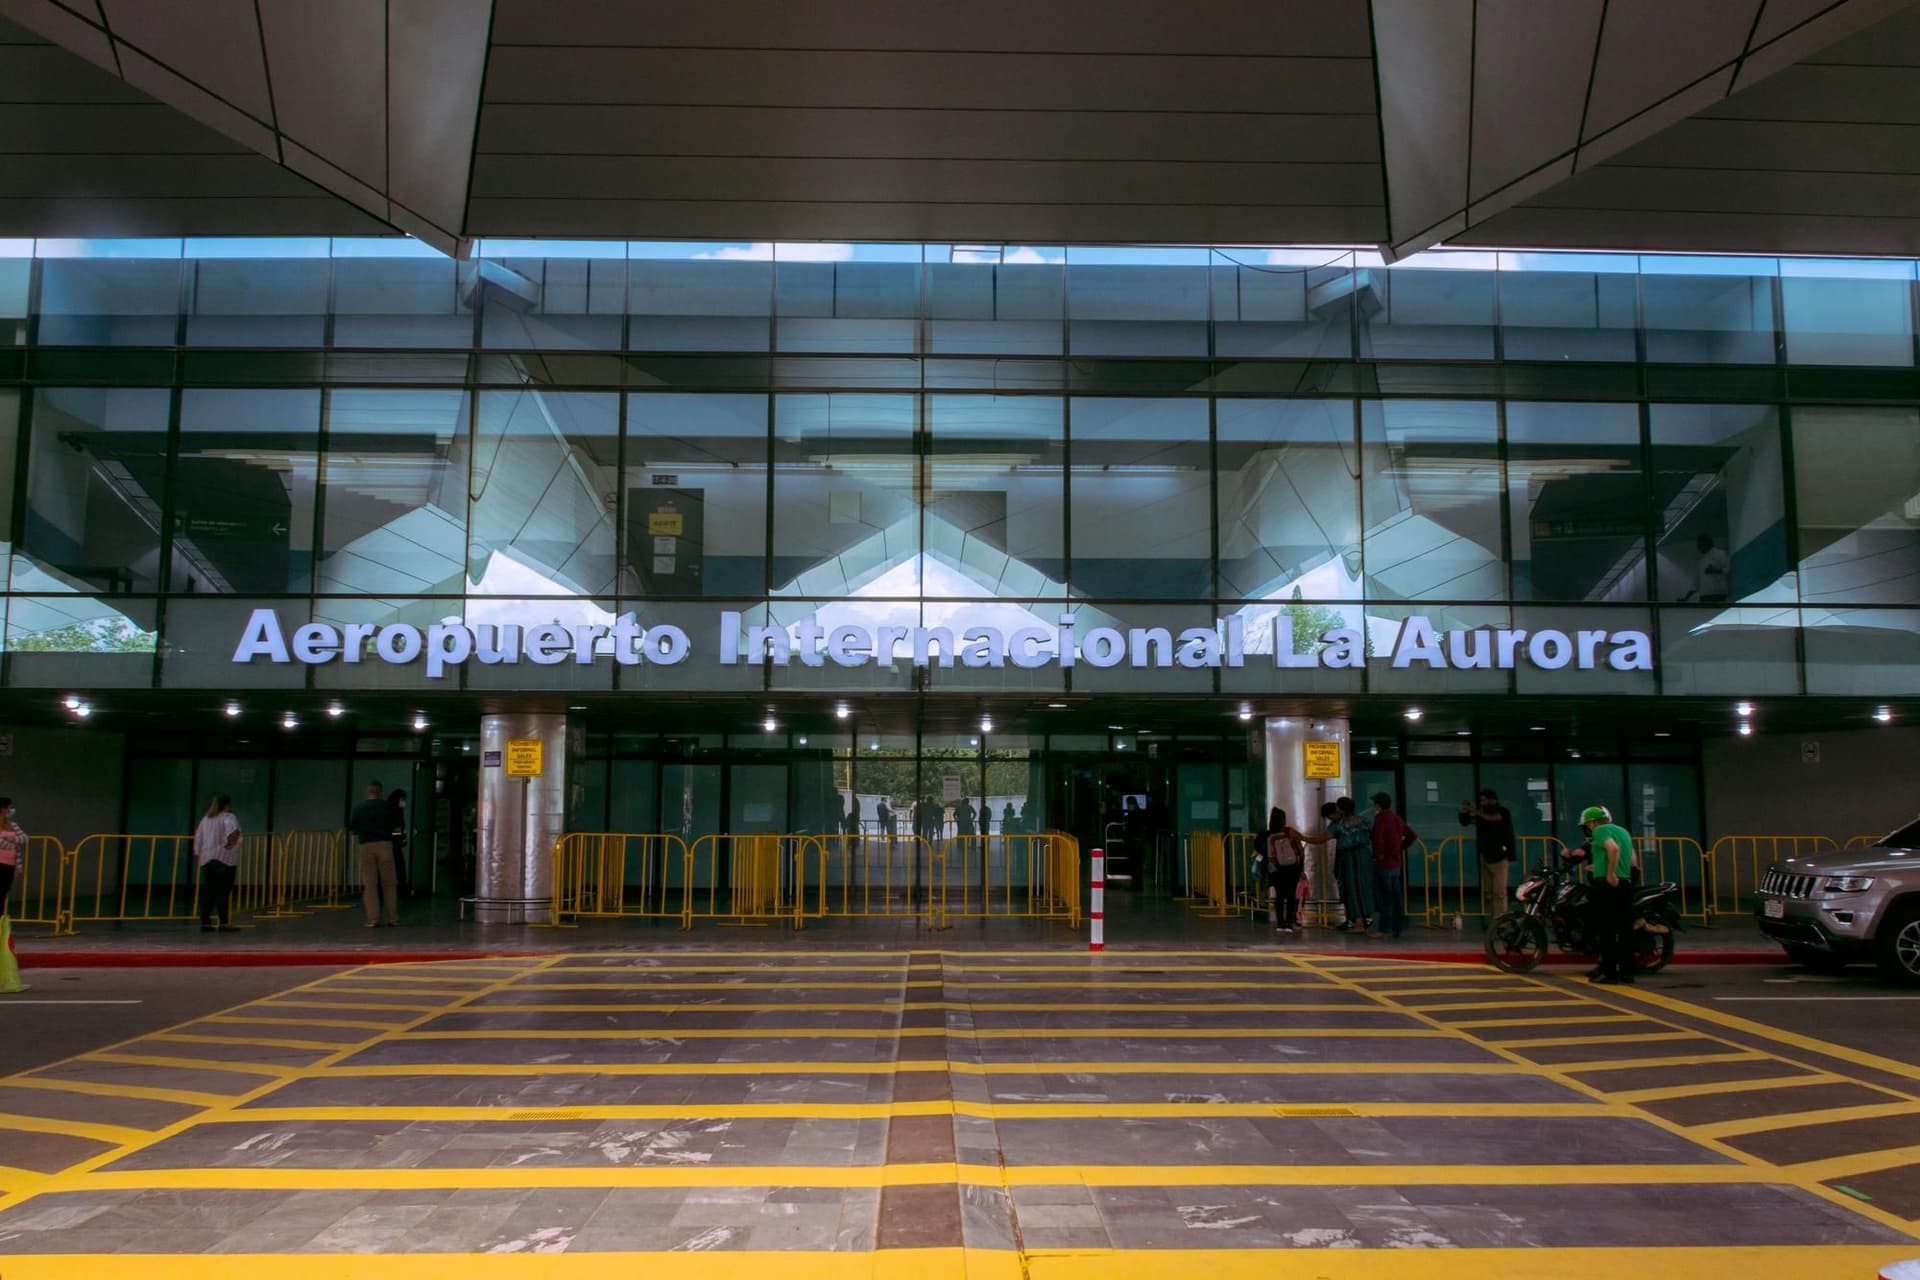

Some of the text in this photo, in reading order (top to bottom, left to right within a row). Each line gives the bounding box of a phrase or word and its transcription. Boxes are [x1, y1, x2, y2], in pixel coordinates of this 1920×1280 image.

[232, 607, 1654, 678] Aeropuerto Internacional La Aurora
